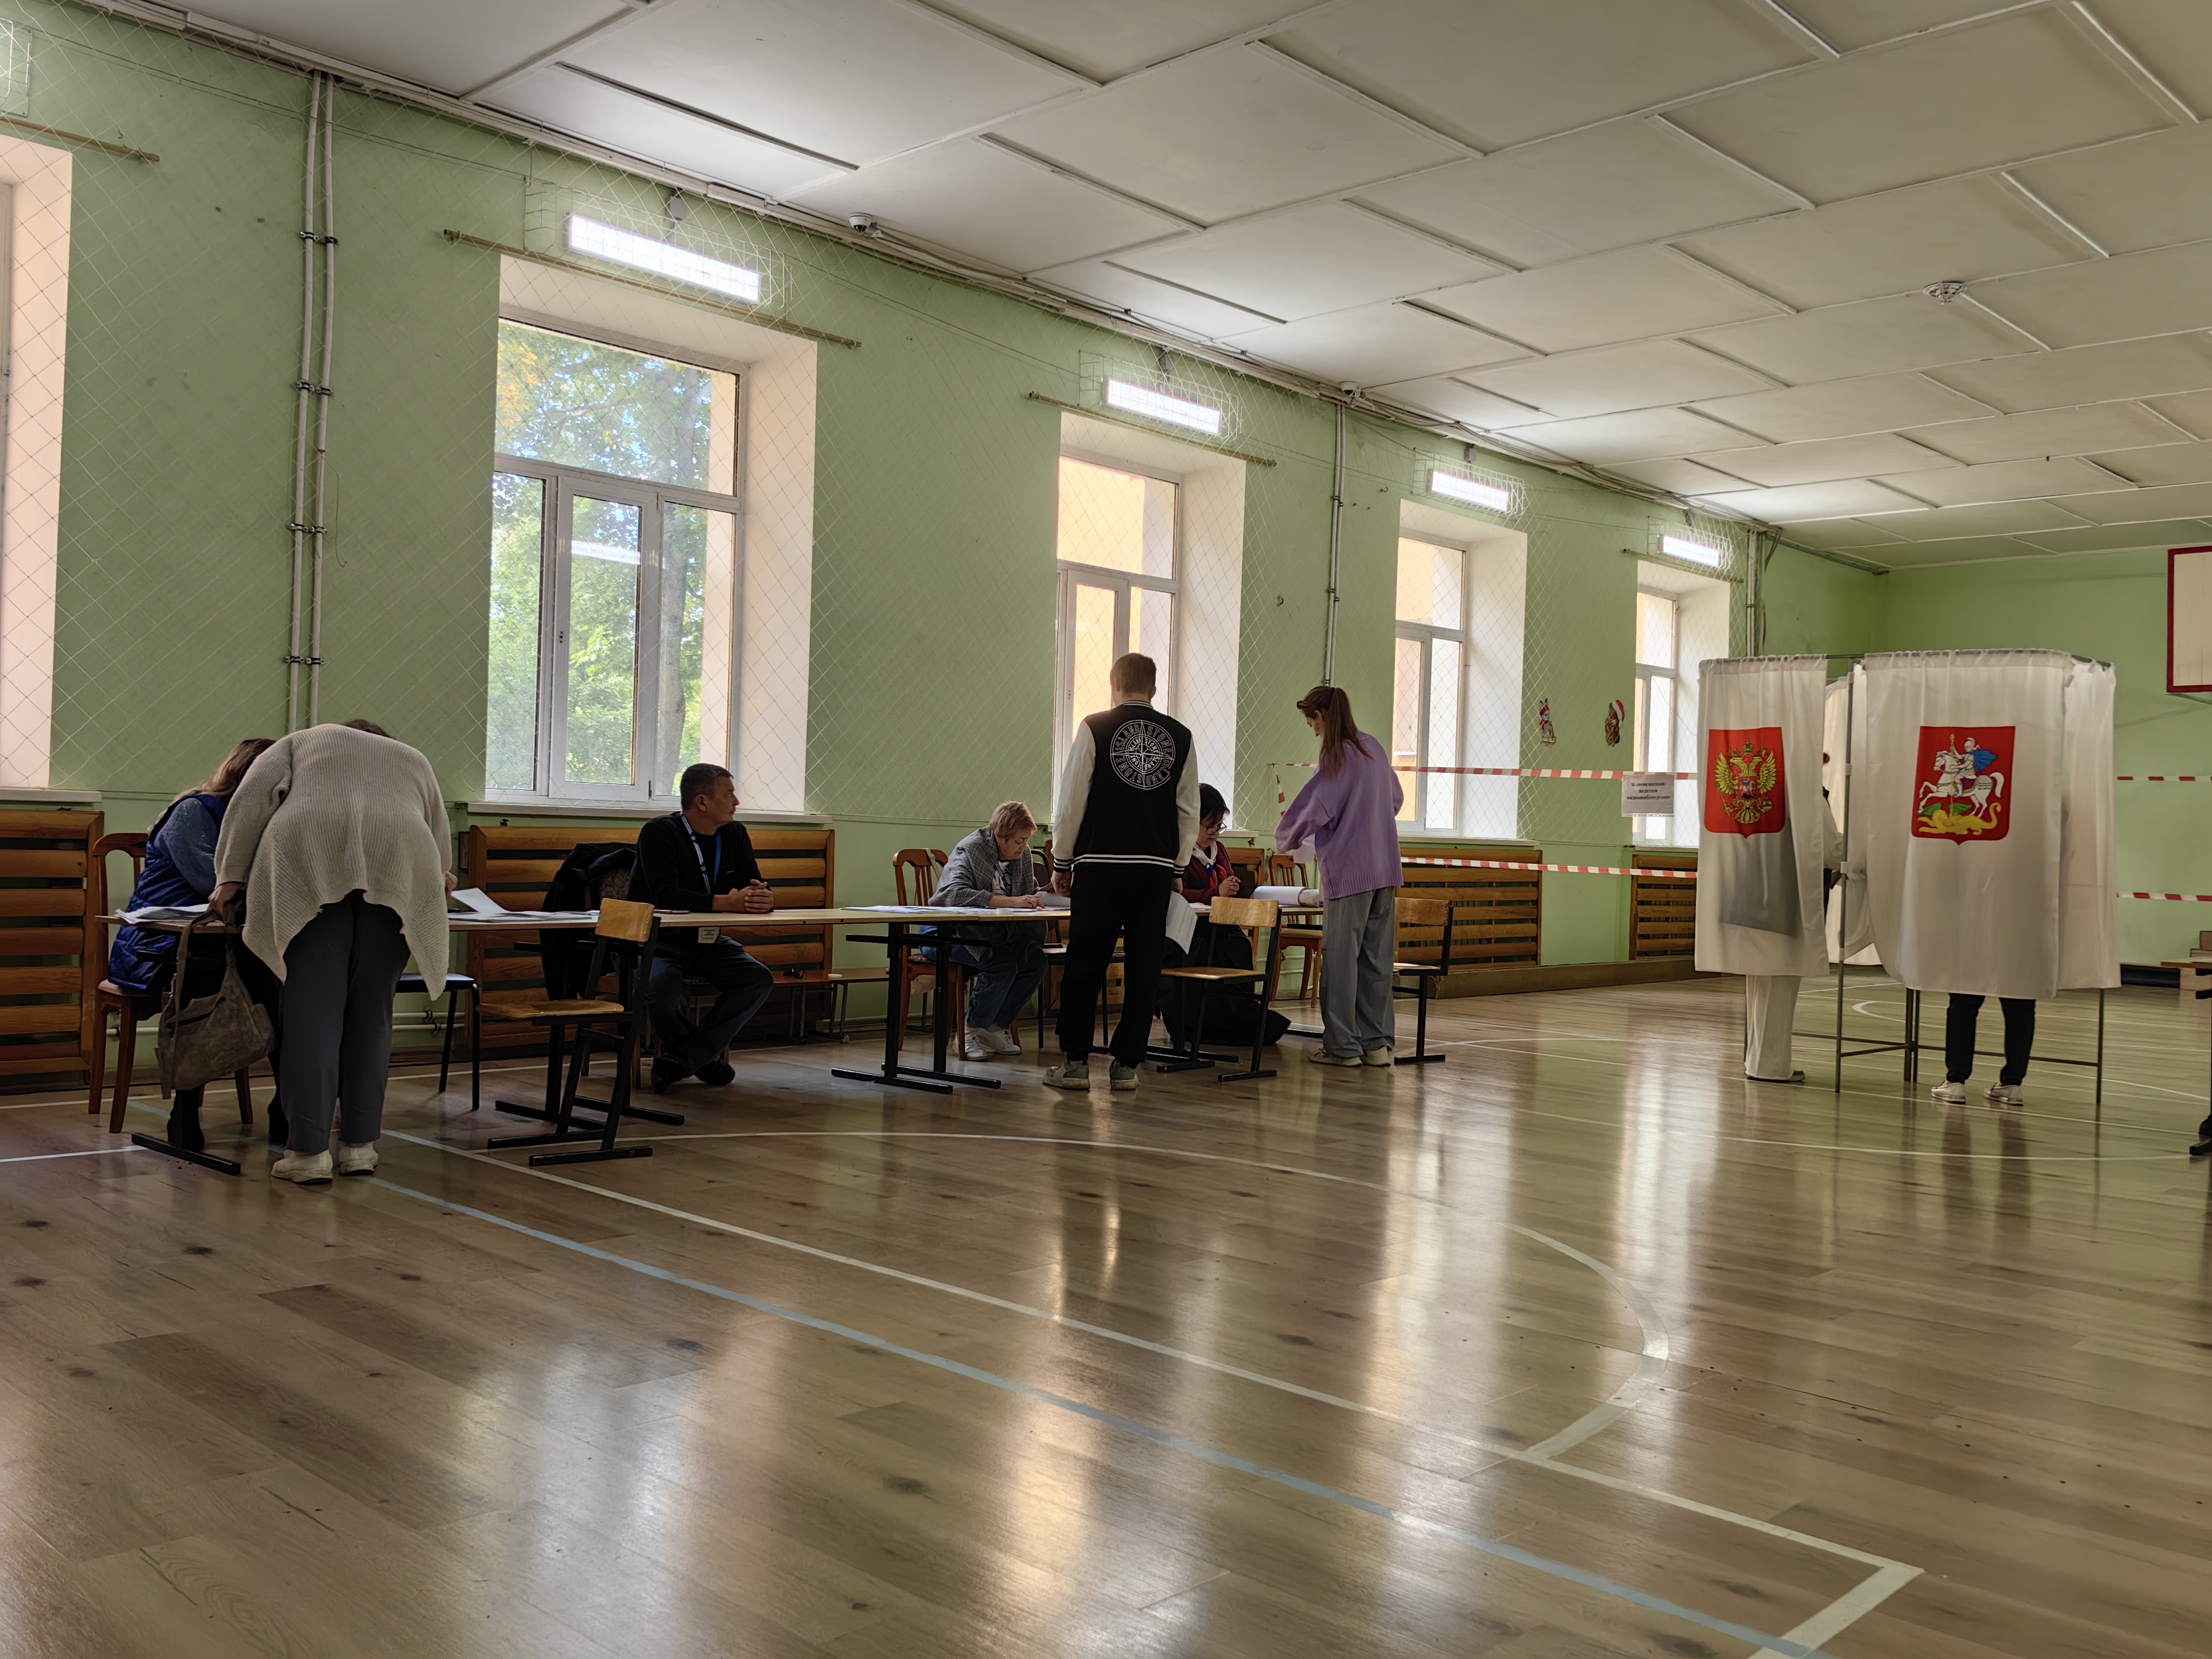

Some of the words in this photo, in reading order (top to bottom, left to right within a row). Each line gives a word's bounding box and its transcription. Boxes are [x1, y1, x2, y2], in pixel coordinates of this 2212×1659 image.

[1115, 724, 1140, 750] ISLAND
[1146, 726, 1172, 753] STONE
[1115, 756, 1142, 784] STONE
[1146, 759, 1171, 785] ISLAND
